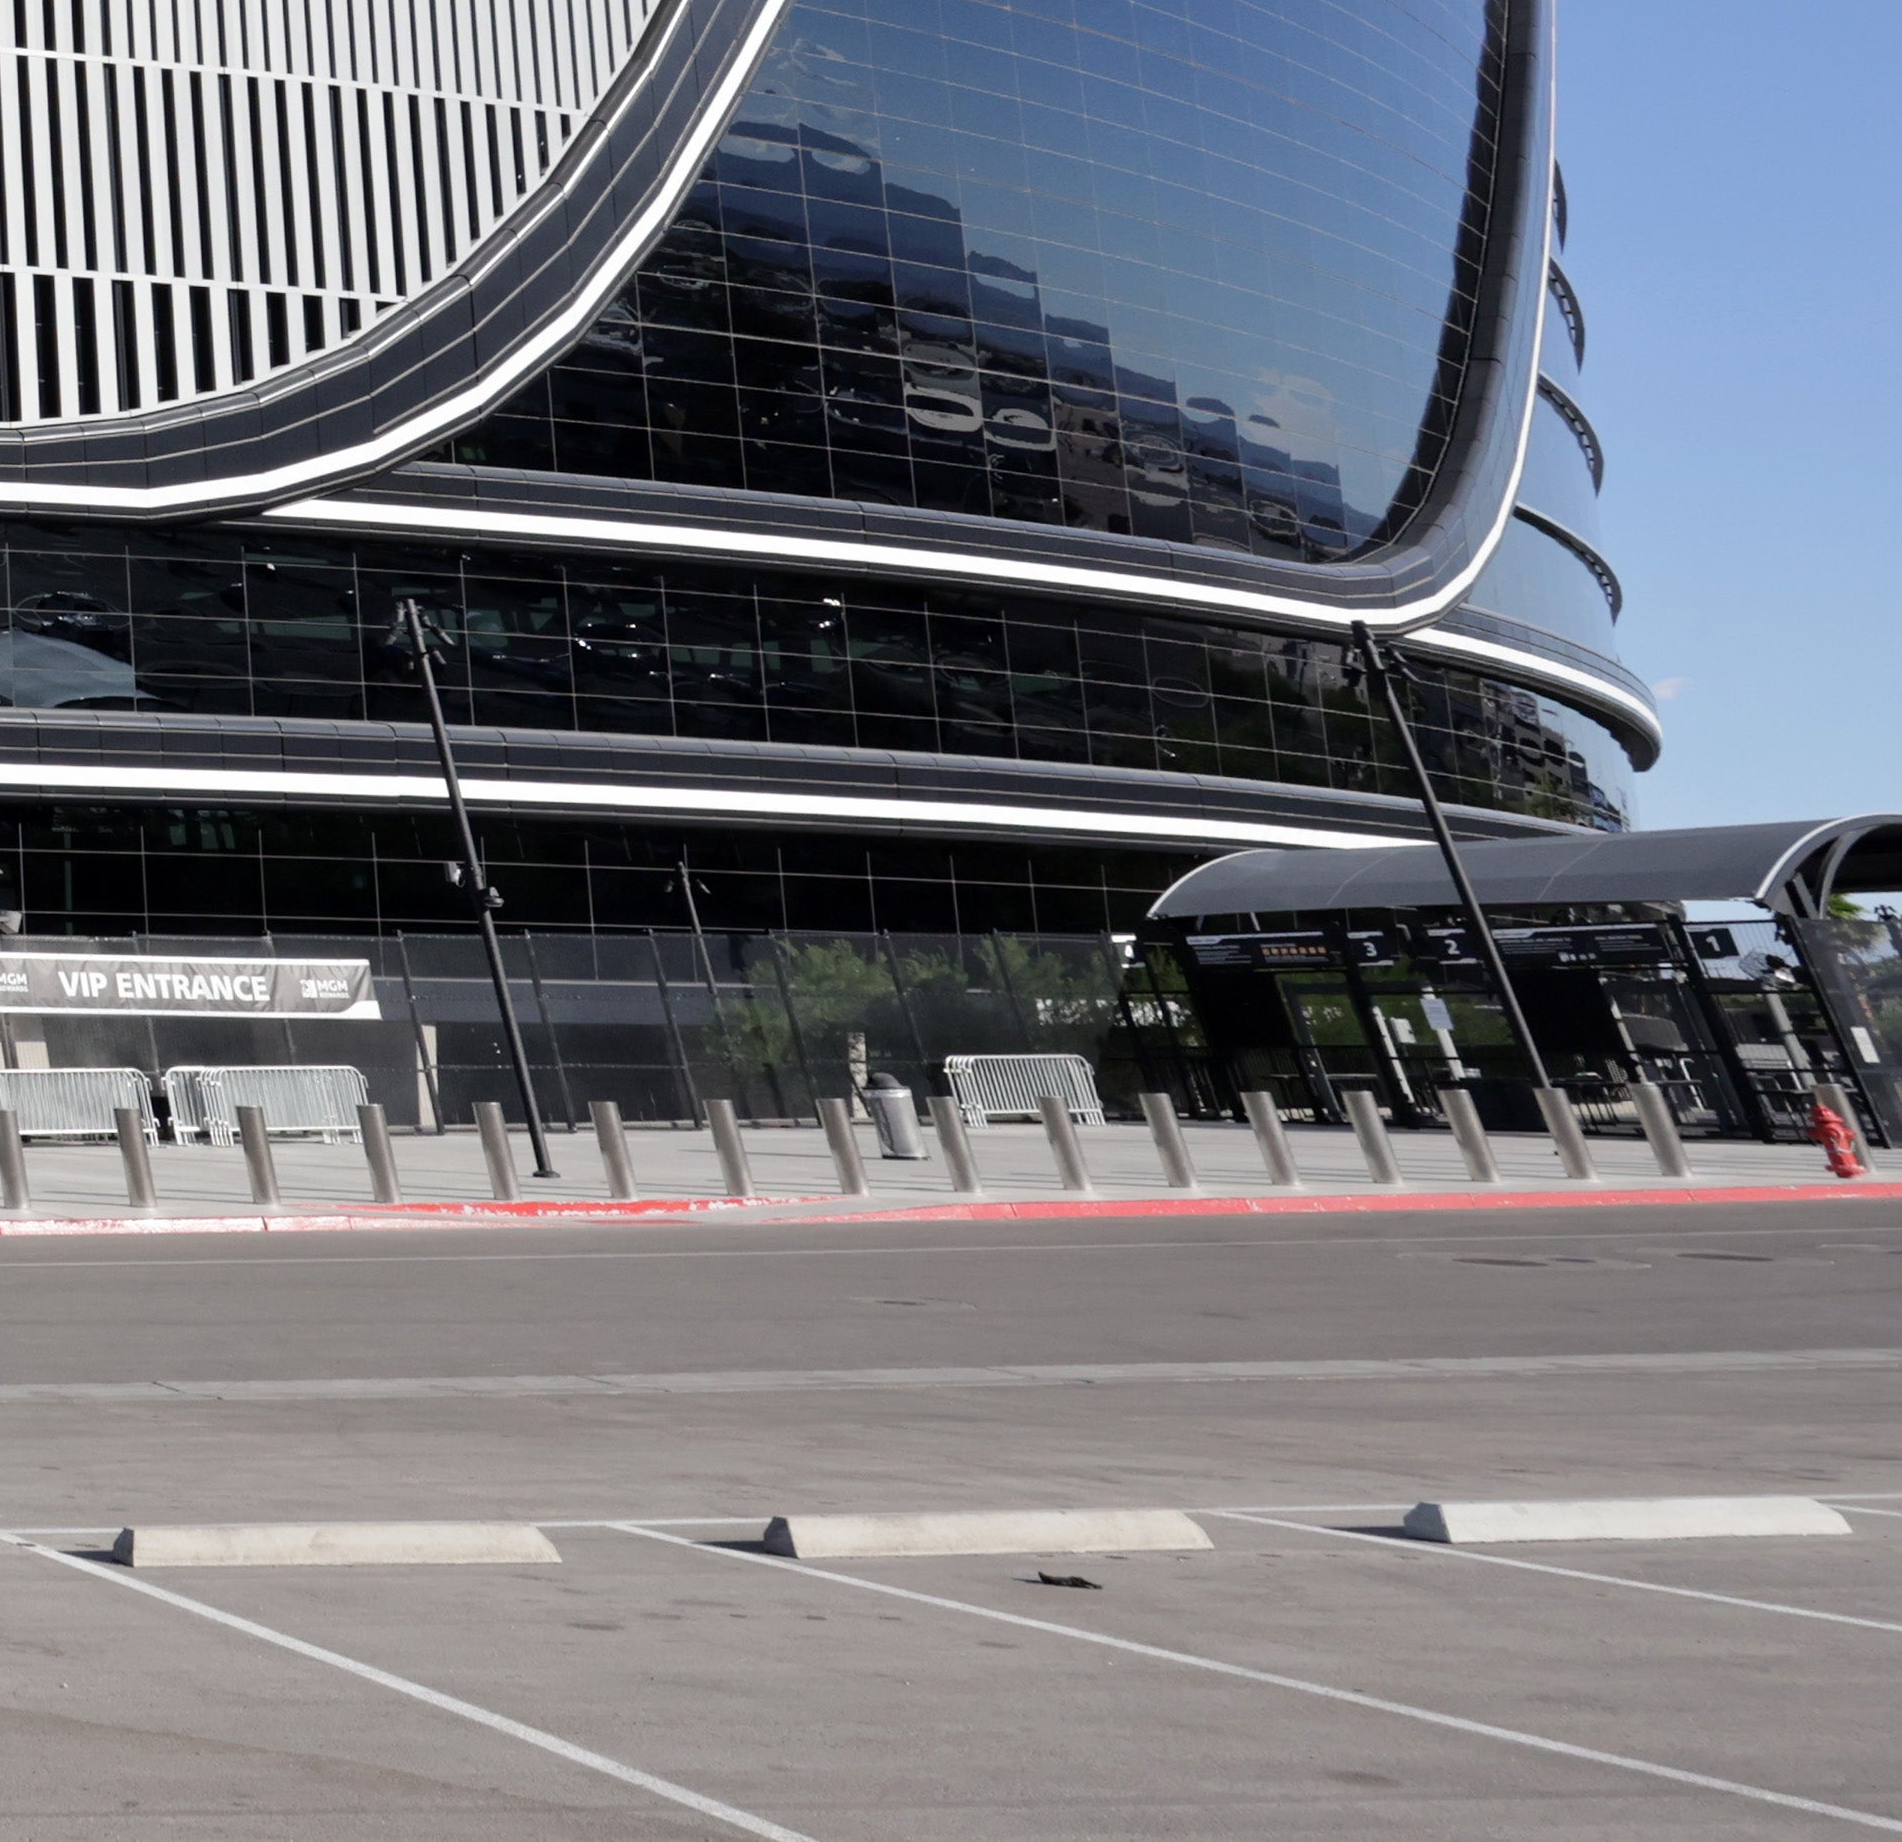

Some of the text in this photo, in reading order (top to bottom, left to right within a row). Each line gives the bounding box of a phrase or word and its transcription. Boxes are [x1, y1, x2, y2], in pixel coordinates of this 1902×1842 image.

[1363, 942, 1377, 957] 3
[1444, 939, 1461, 955] 2
[1705, 935, 1721, 952] 1
[57, 971, 271, 1001] VIP ENTRANCE
[316, 979, 349, 992] MGM
